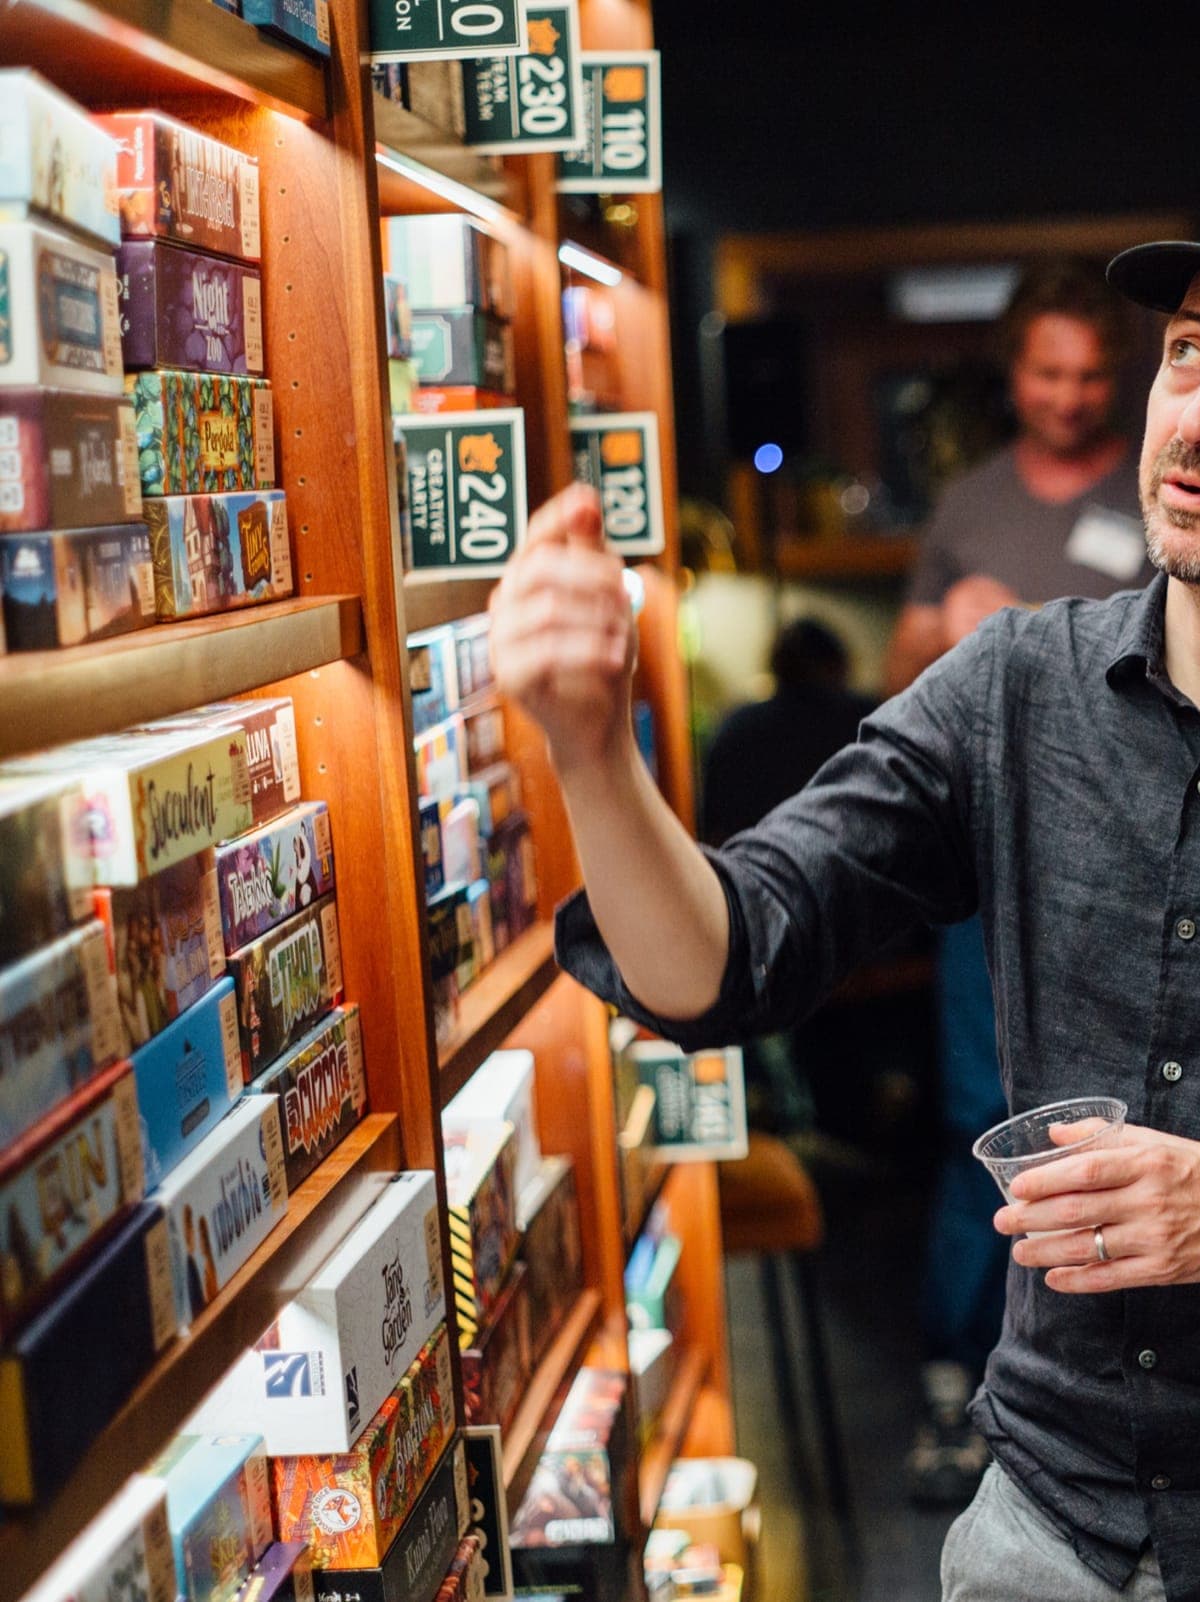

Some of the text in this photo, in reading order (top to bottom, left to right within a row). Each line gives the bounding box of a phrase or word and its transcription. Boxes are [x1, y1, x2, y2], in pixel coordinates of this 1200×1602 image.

[477, 70, 494, 121] TEAM
[519, 56, 568, 134] 230
[603, 109, 646, 170] 110
[409, 464, 428, 530] PARTY
[426, 448, 445, 545] CREATIVE
[459, 473, 509, 560] 240
[603, 466, 647, 537] 120
[381, 1298, 412, 1366] Garden
